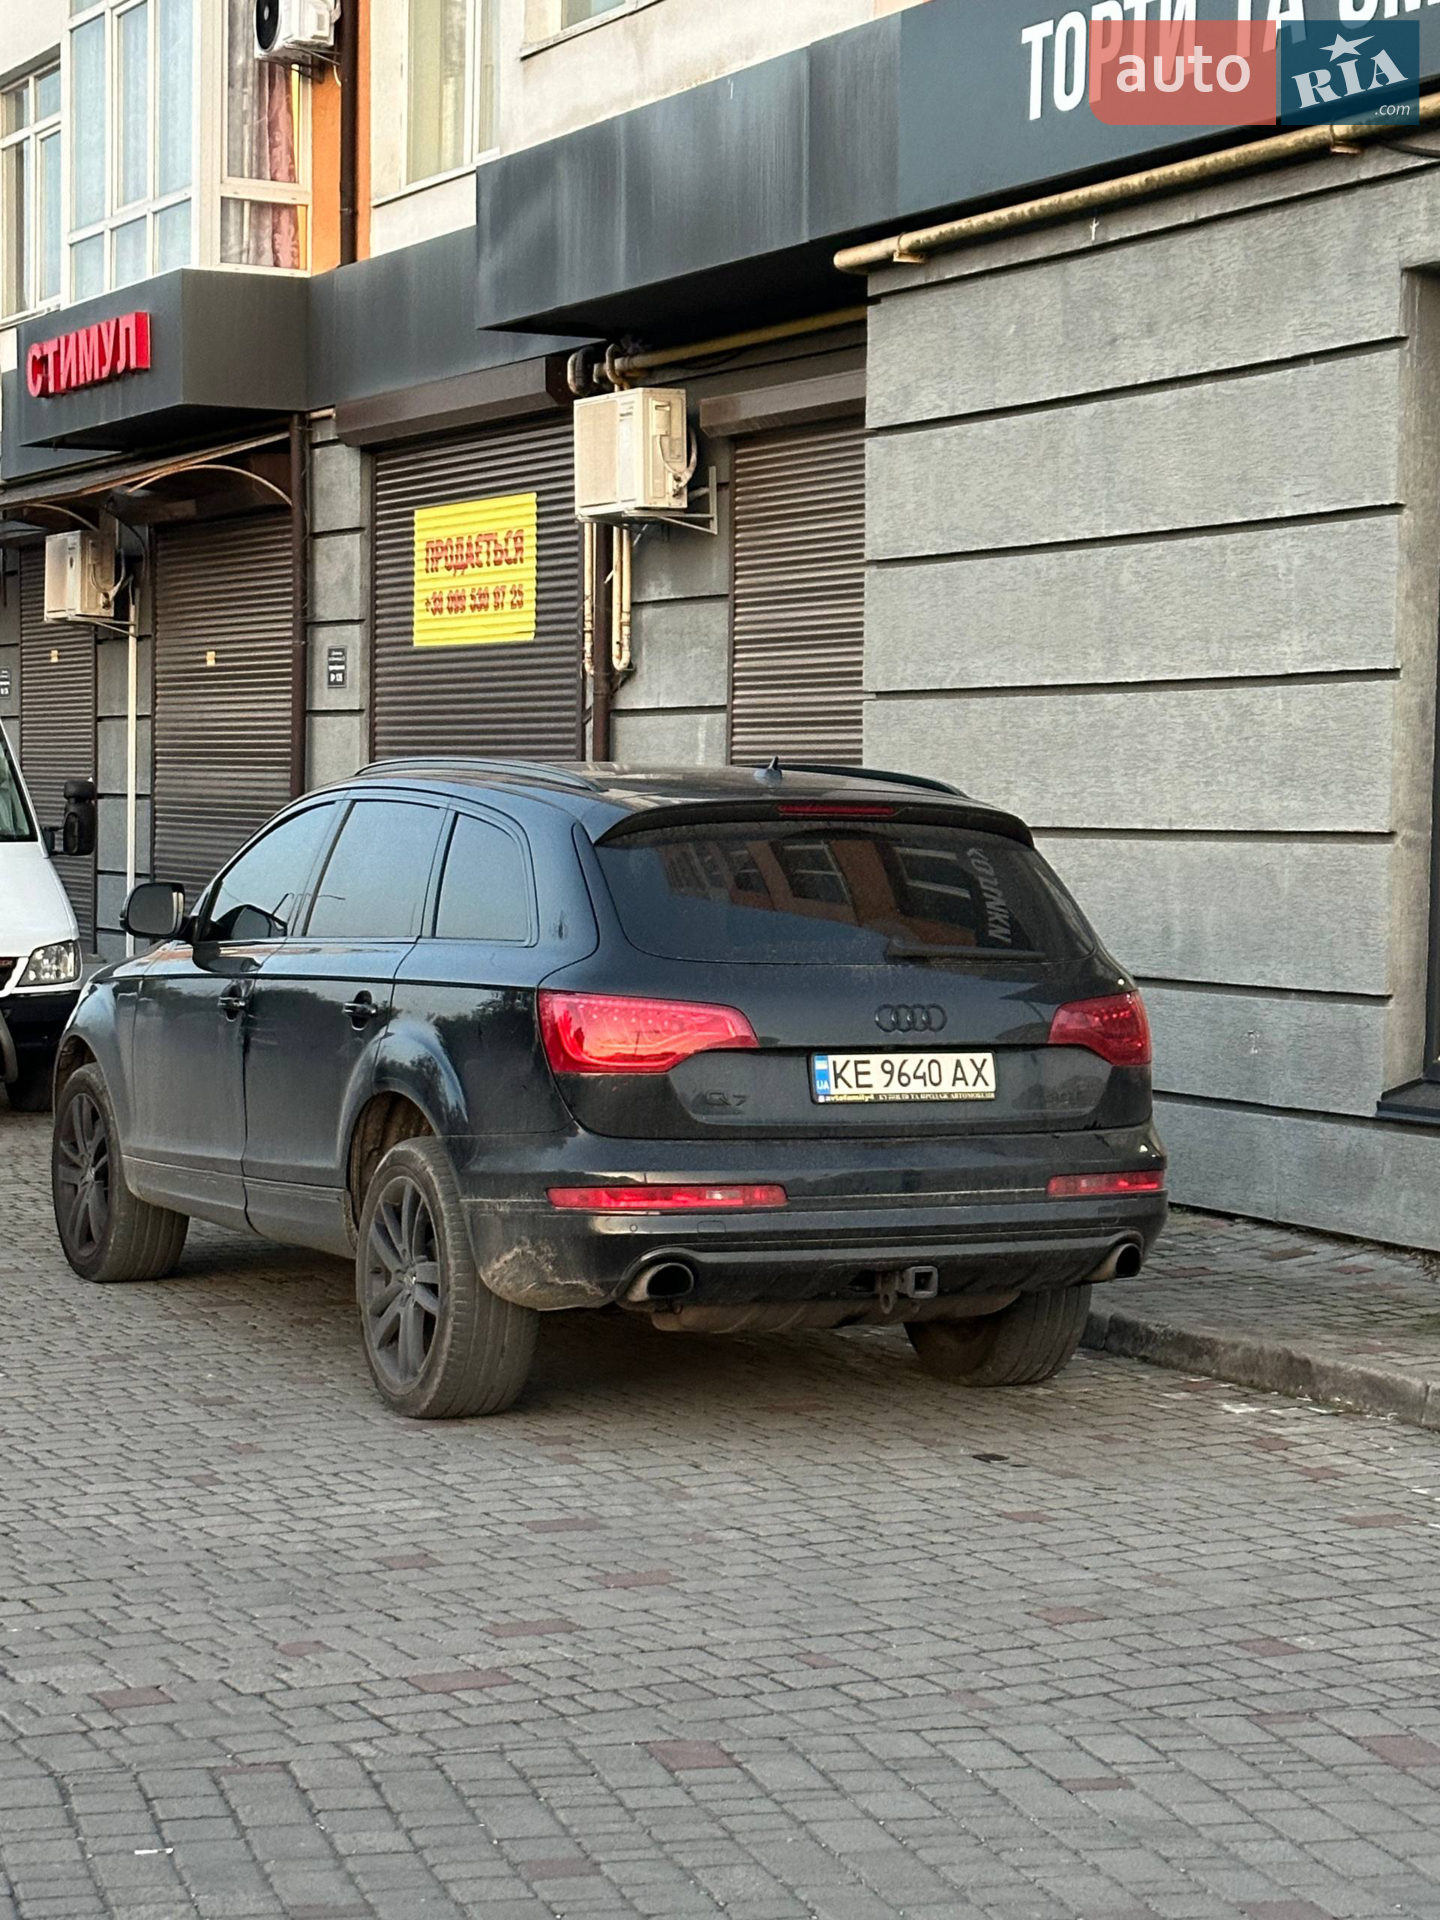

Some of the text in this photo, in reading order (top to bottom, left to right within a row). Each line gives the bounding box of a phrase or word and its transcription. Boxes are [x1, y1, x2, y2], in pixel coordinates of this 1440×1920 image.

[1021, 0, 1198, 121] ТОРТИ
[27, 311, 149, 398] СТИМУЛ
[816, 1080, 829, 1090] UA
[832, 1058, 990, 1089] KE 9640 AX
